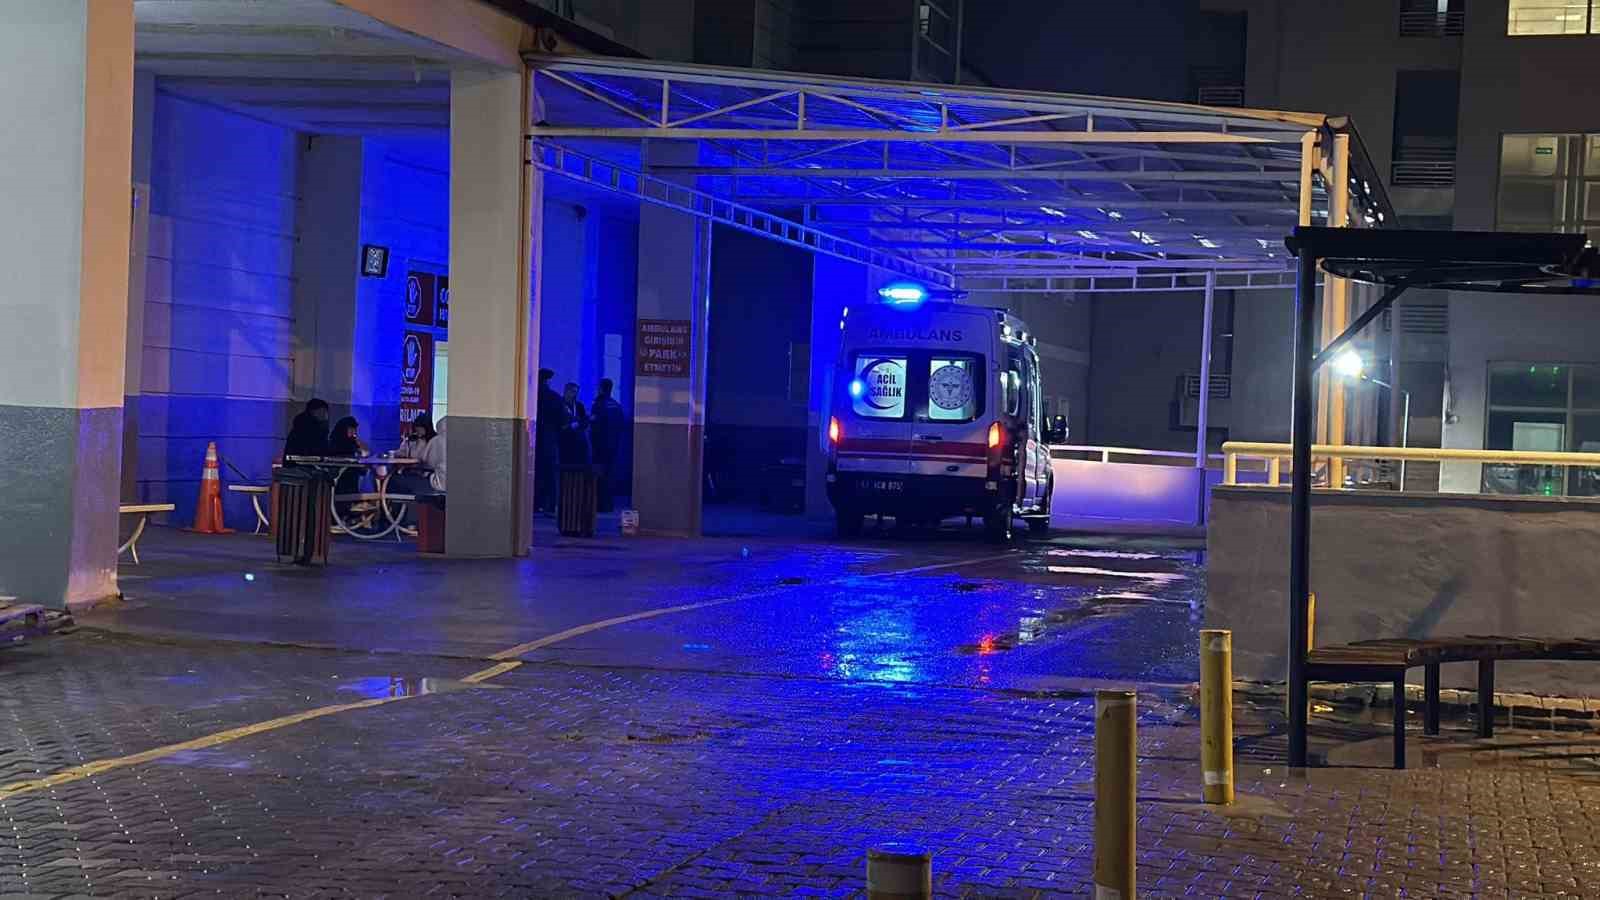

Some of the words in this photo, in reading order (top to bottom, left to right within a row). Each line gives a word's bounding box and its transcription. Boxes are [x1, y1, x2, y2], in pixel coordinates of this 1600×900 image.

[868, 328, 963, 342] AMBULANS
[648, 348, 680, 360] PARK
[876, 373, 896, 385] ACİL
[871, 386, 903, 398] SAĞLIK
